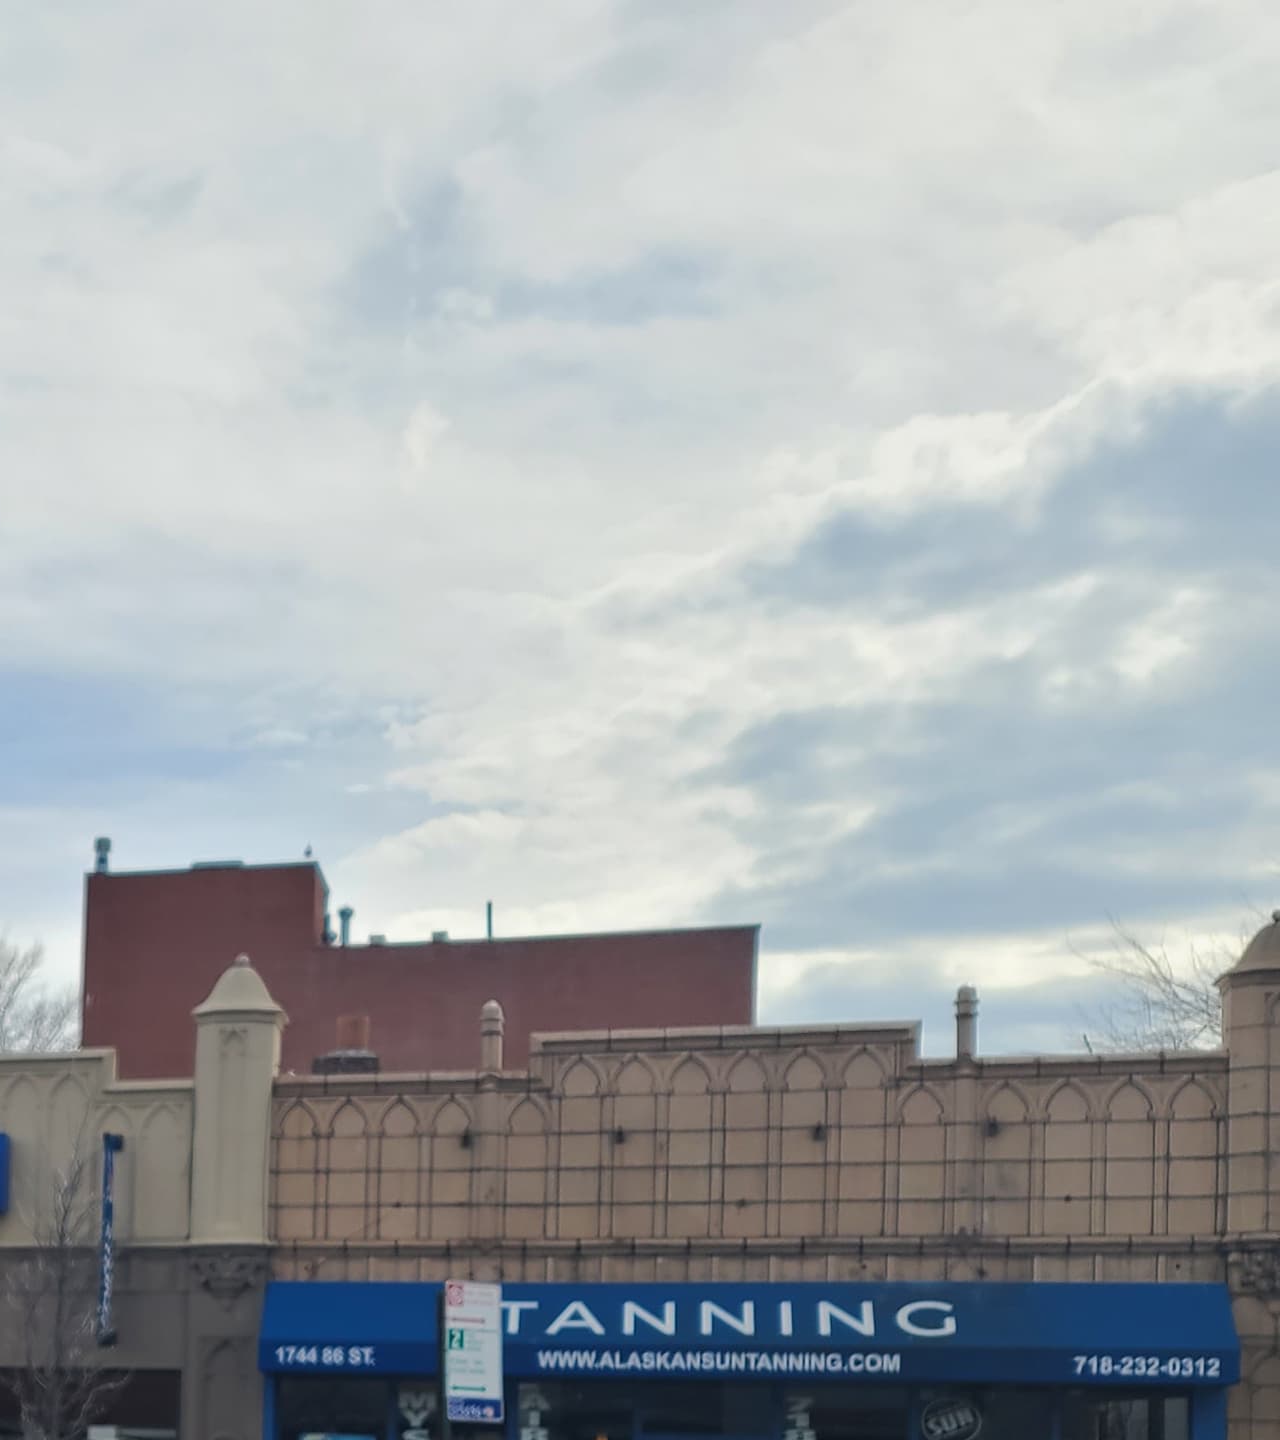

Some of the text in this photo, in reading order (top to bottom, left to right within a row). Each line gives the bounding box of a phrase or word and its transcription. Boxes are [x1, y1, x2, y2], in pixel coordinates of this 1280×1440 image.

[501, 1300, 957, 1337] TANNING
[320, 1347, 344, 1365] 86
[537, 1351, 901, 1373] WWW.ALASKANSUNTANNING.COM
[1073, 1355, 1221, 1377] 718-232-0312
